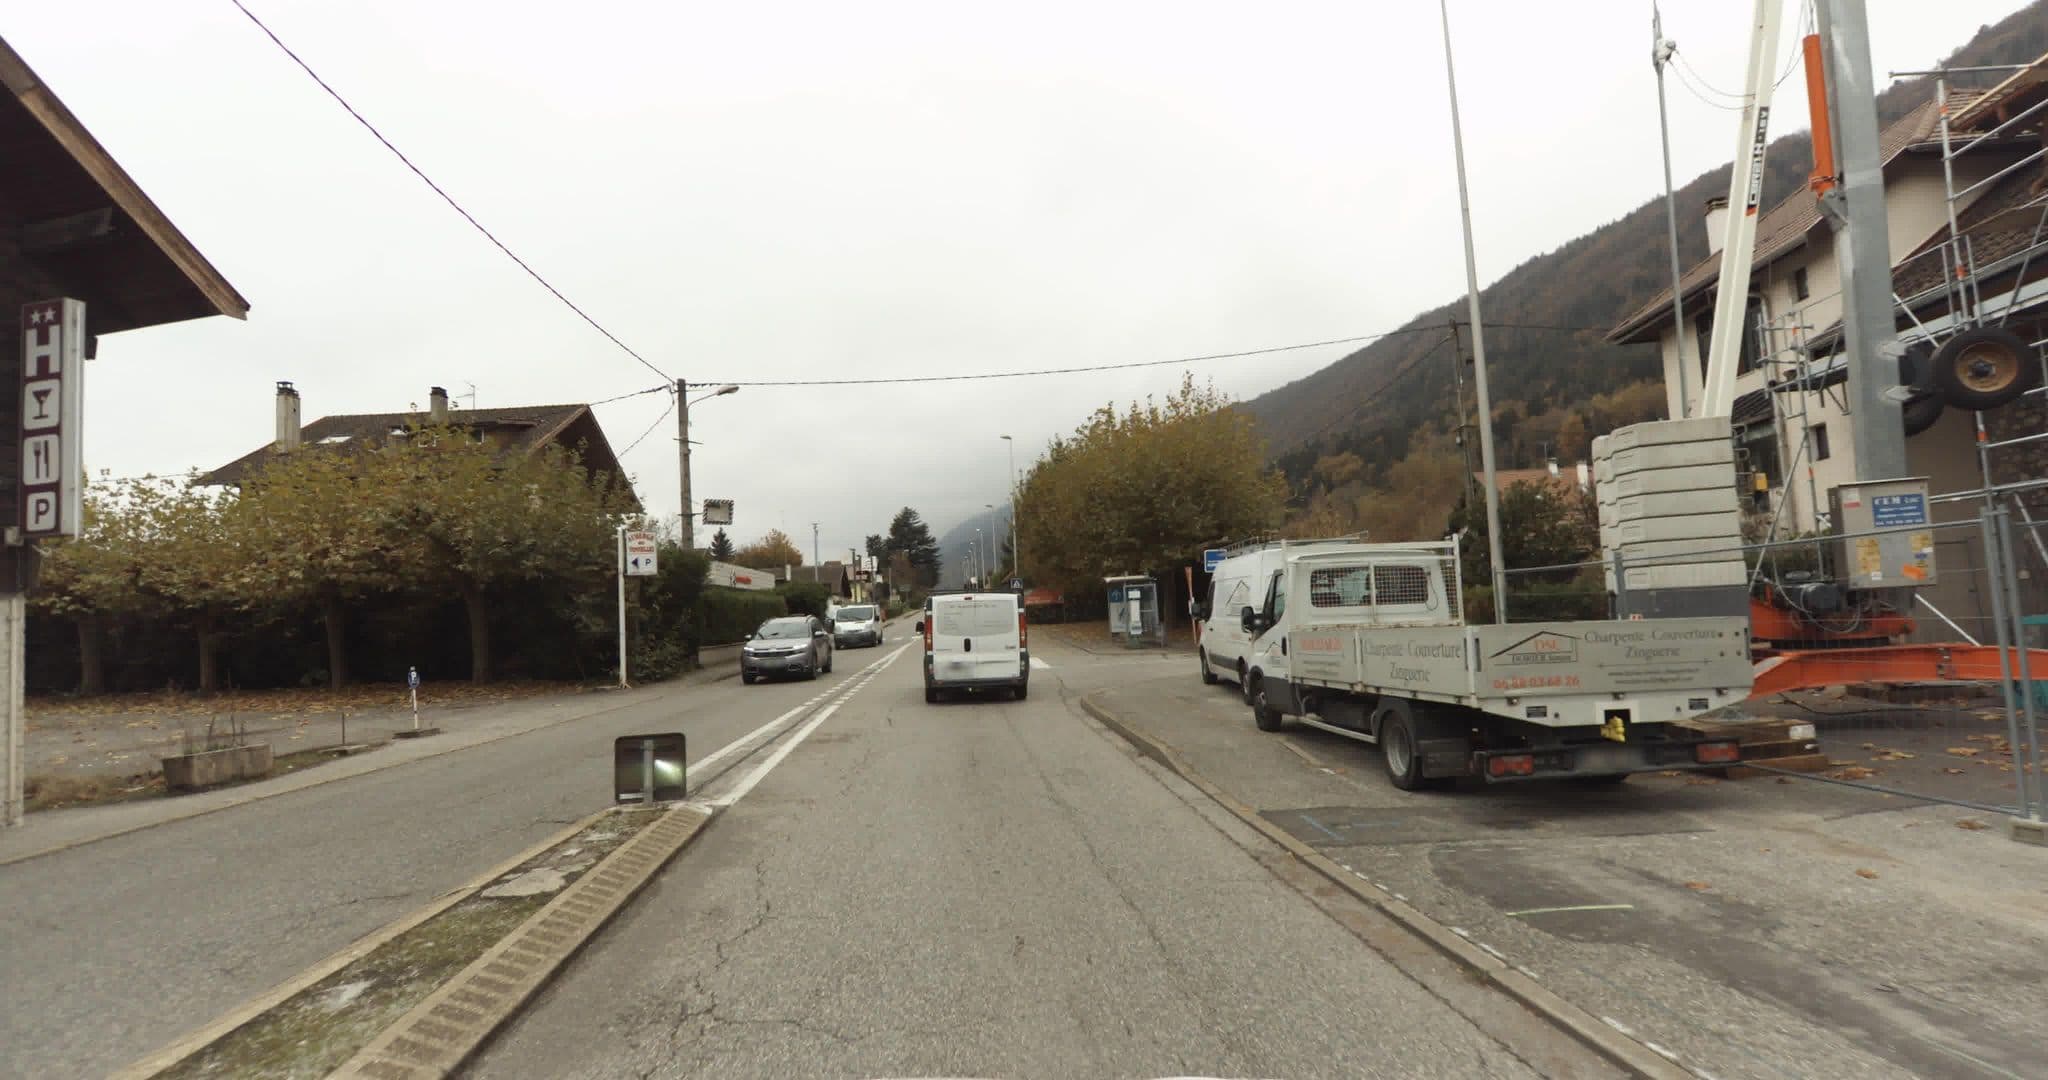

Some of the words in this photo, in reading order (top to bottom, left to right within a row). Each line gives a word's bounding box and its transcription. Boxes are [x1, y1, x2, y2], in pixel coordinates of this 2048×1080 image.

[25, 324, 61, 377] H
[35, 499, 49, 524] P
[645, 558, 652, 567] P
[1584, 630, 1645, 646] Charpente
[1651, 628, 1717, 641] Couverture
[1363, 638, 1403, 660] Charpente
[1408, 639, 1461, 658] Couverture
[1625, 646, 1681, 662] Zinguerie
[1390, 661, 1431, 686] Zinguerie
